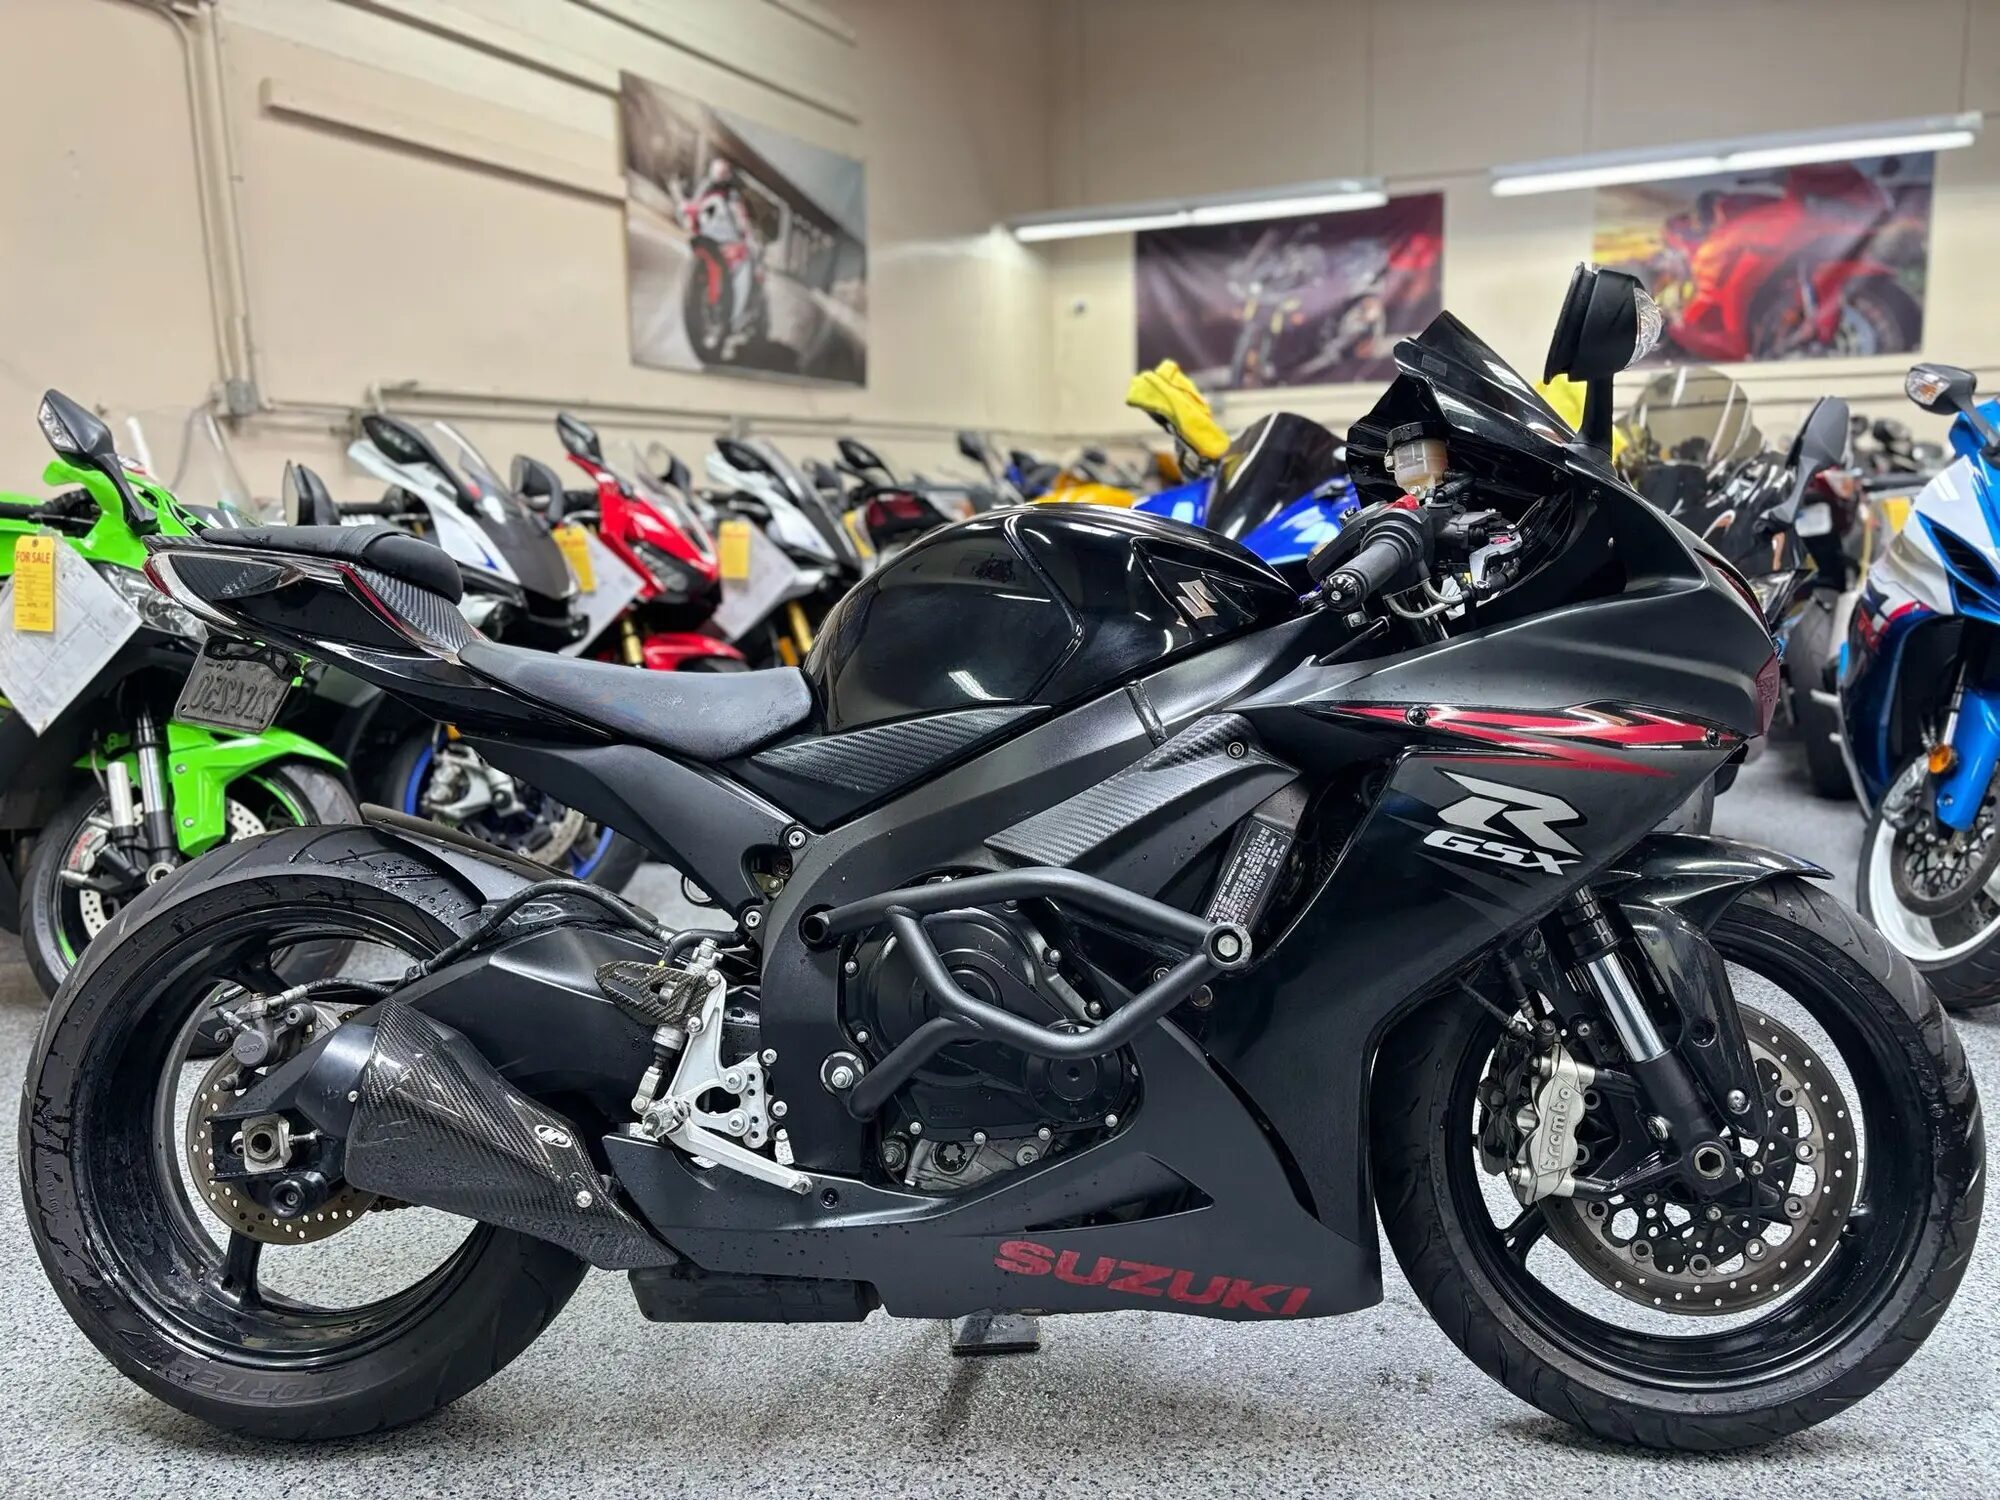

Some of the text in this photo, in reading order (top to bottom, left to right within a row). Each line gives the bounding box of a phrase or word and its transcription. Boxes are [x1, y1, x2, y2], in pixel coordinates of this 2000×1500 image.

[16, 551, 51, 564] FOR SALE
[1423, 829, 1582, 876] GSX
[1541, 1087, 1572, 1170] brembo
[994, 1240, 1312, 1315] SUZUKI
